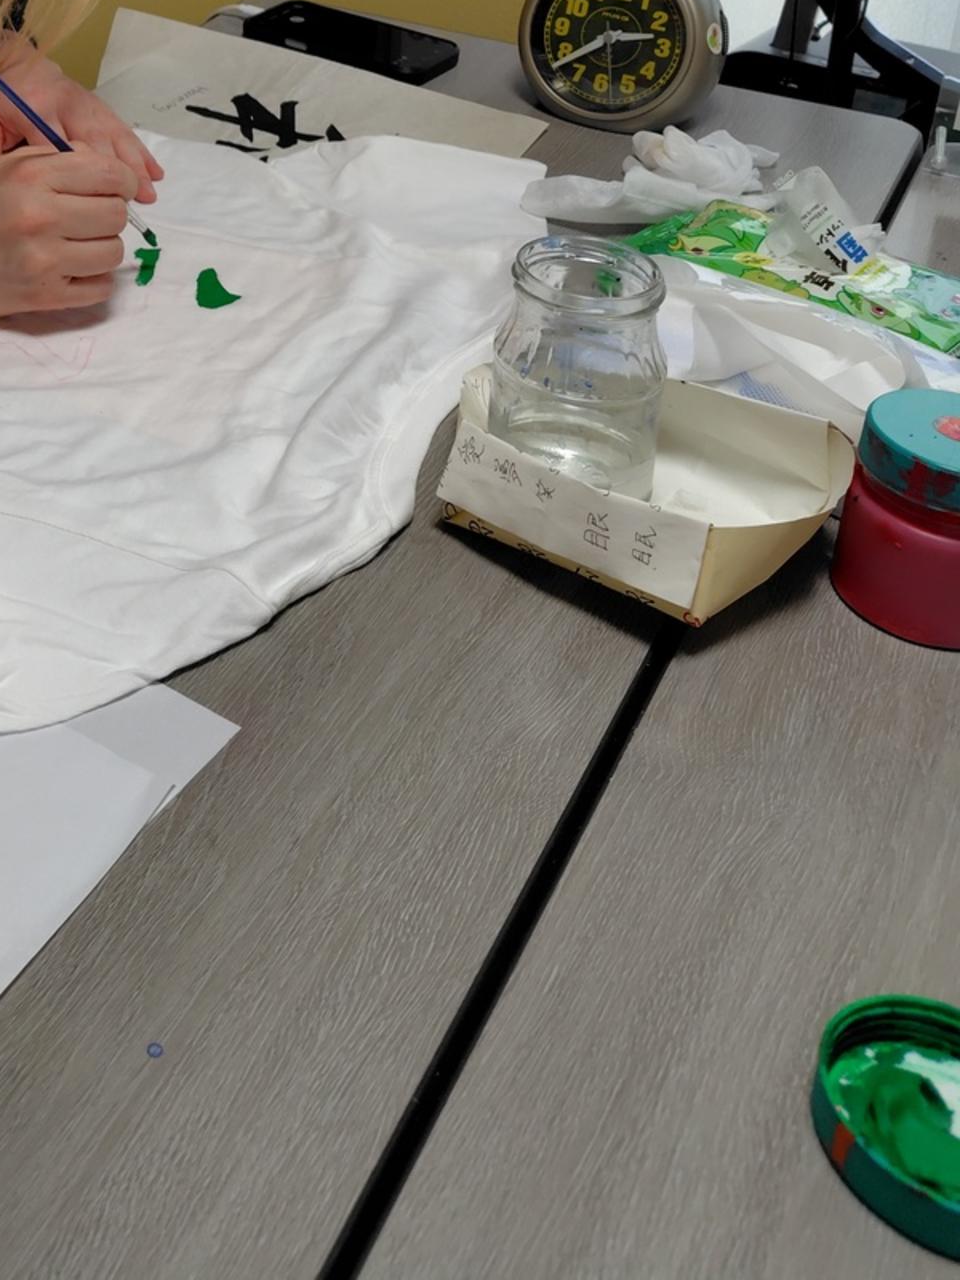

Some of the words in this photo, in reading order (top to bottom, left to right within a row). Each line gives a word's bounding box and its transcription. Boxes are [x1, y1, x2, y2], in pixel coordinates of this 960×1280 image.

[555, 18, 570, 36] 9
[651, 12, 668, 32] 2
[654, 38, 671, 58] 3
[572, 64, 586, 82] 7
[640, 61, 656, 80] 4
[593, 74, 609, 93] 6
[619, 74, 635, 94] 5
